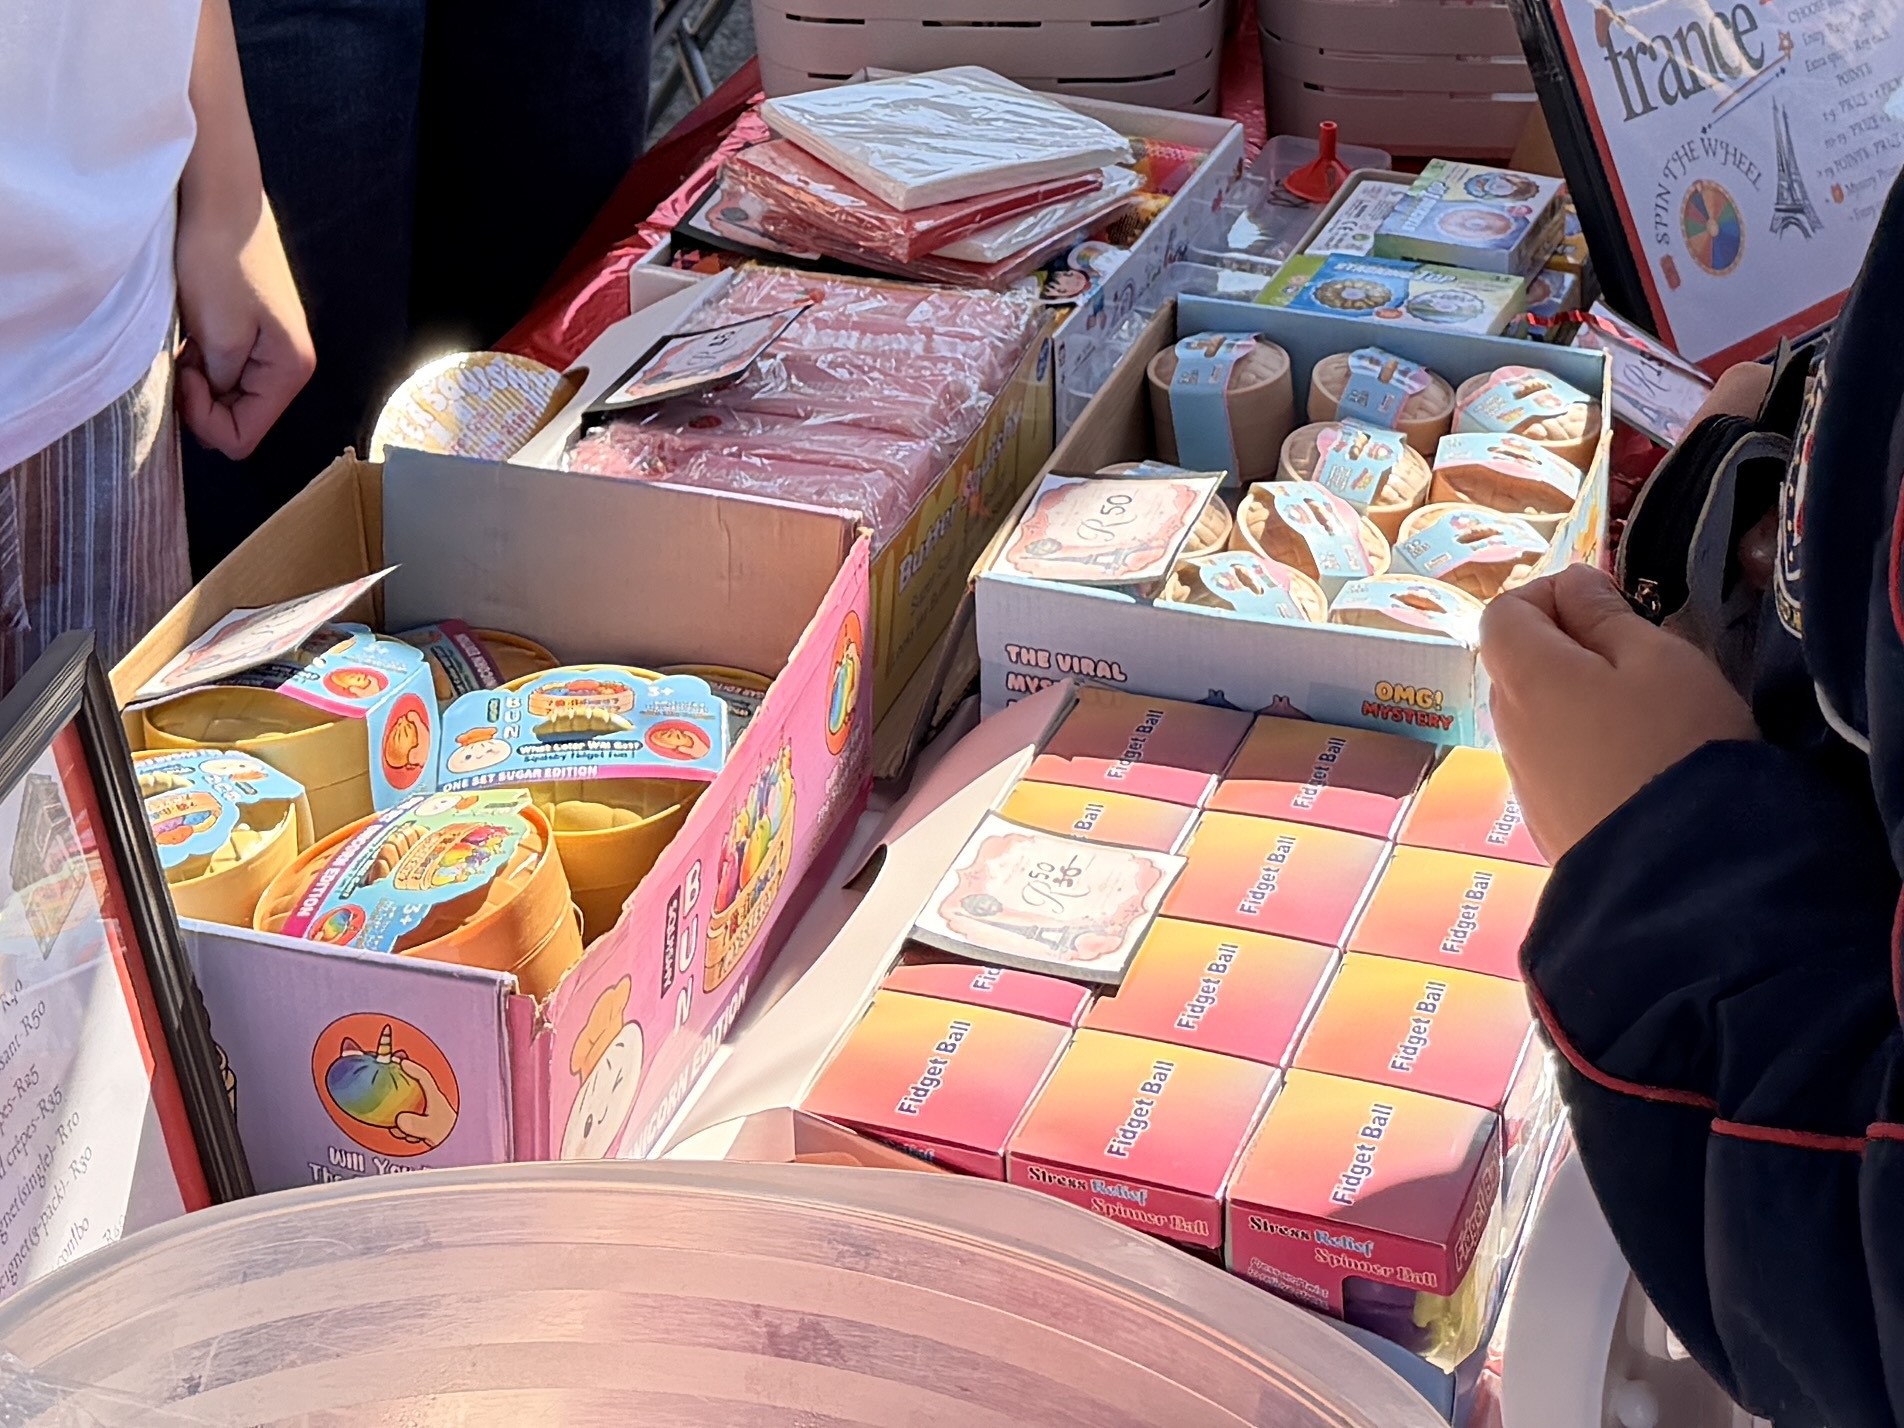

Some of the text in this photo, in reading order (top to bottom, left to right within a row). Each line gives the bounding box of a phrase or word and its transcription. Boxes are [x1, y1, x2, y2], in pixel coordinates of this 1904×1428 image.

[1654, 136, 1763, 246] SPIN THE WHEEL
[1005, 643, 1128, 683] THE VIRAL
[1005, 672, 1058, 695] MYS
[1361, 700, 1455, 731] MYSTERY
[1374, 680, 1444, 711] OMG!
[1106, 708, 1165, 779] Fidget Ball
[1292, 736, 1348, 810] Fidget Ball
[442, 765, 599, 794] ONE SET SUGAR EDITION
[1073, 802, 1105, 834] Ball
[296, 862, 341, 919] EDITION
[1239, 835, 1297, 916] Fidget Ball
[1441, 871, 1494, 954] Fidget Ball
[674, 858, 703, 1035] BUN
[1175, 943, 1239, 1030] Fidget Ball
[691, 974, 749, 1076] EDITION
[1390, 980, 1447, 1072] Fidget Ball
[897, 1057, 949, 1116] Fidget
[936, 1019, 972, 1055] Ball
[1105, 1059, 1176, 1159] Fidget Ball
[328, 1145, 366, 1172] Will
[1027, 1165, 1149, 1208] Stress Relief
[1330, 1103, 1394, 1206] Fidget Ball
[1090, 1195, 1210, 1238] Spinner Ball
[1248, 1215, 1375, 1259] Stress Relief
[1315, 1248, 1439, 1289] Spinner Ball
